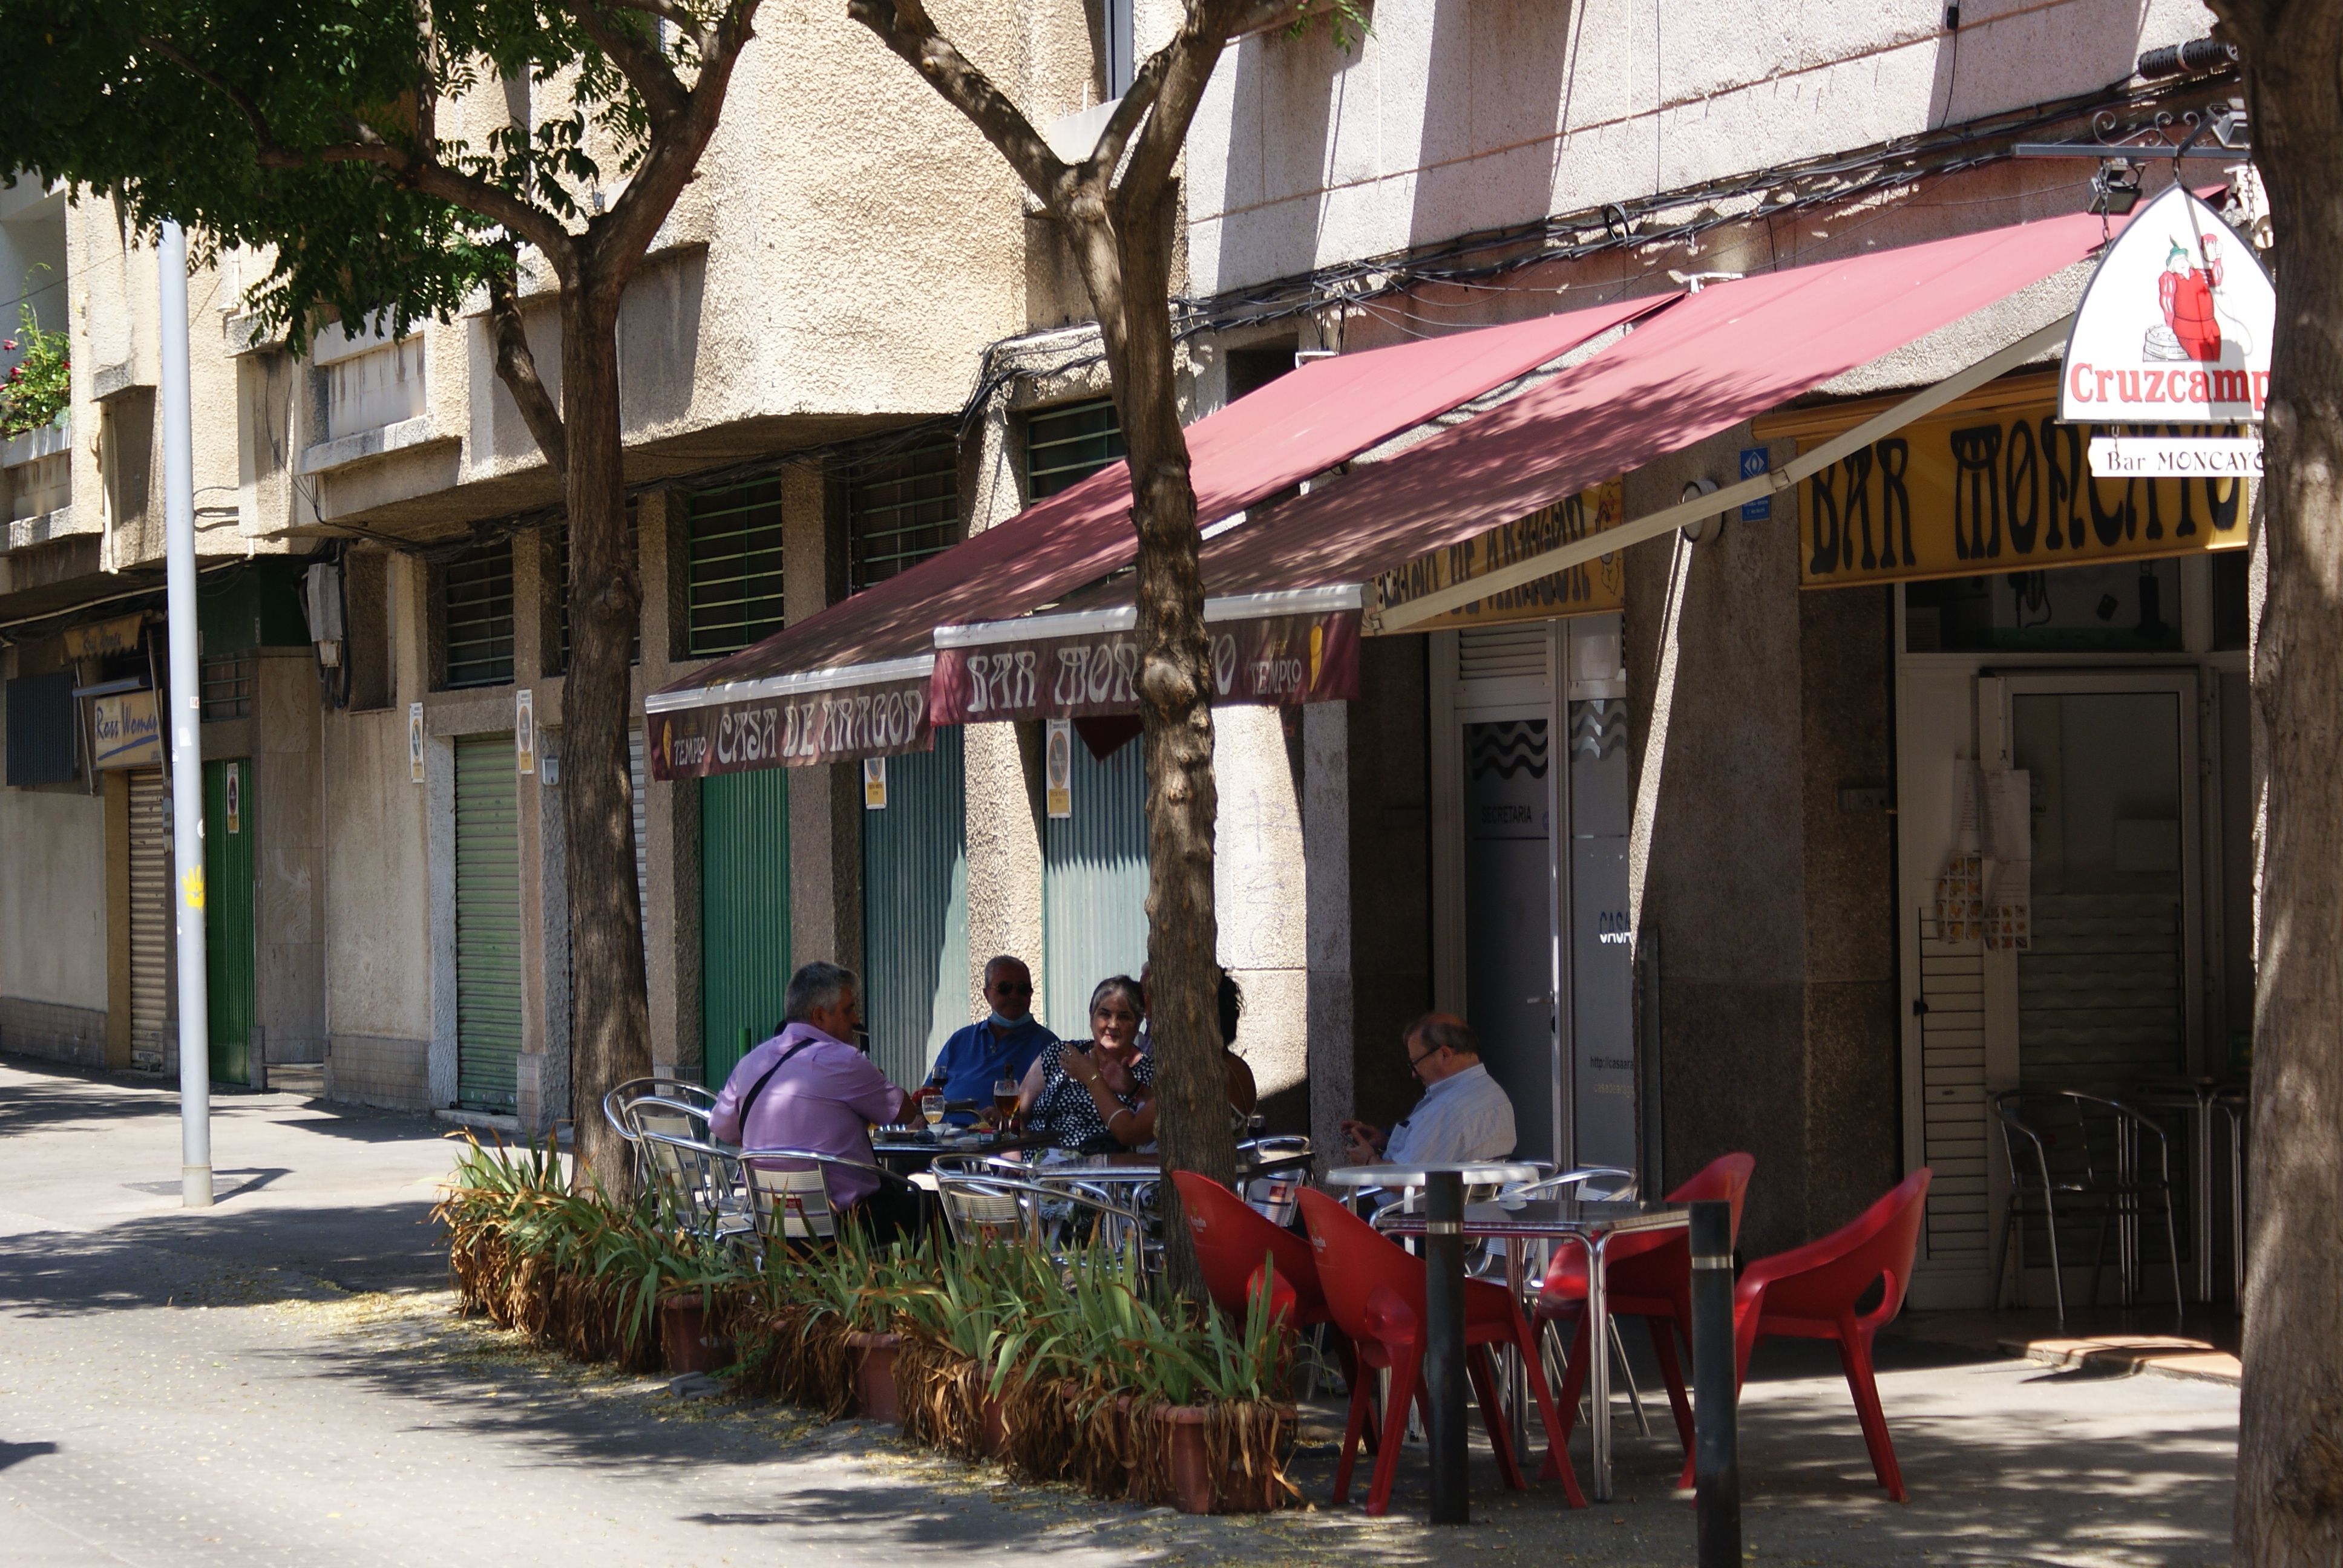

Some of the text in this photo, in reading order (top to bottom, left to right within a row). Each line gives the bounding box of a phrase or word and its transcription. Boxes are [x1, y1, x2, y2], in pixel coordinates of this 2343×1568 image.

[2070, 364, 2270, 412] Cruzcamp
[2108, 451, 2264, 471] Bar MONCAYO
[1810, 437, 1916, 575] BAR
[968, 633, 1236, 713] BAR MONO
[1250, 658, 1302, 695] TEMPLO
[716, 689, 924, 764] CASA DE ARAGON
[1481, 804, 1532, 824] SECRETARIA
[1599, 910, 1634, 944] CASA
